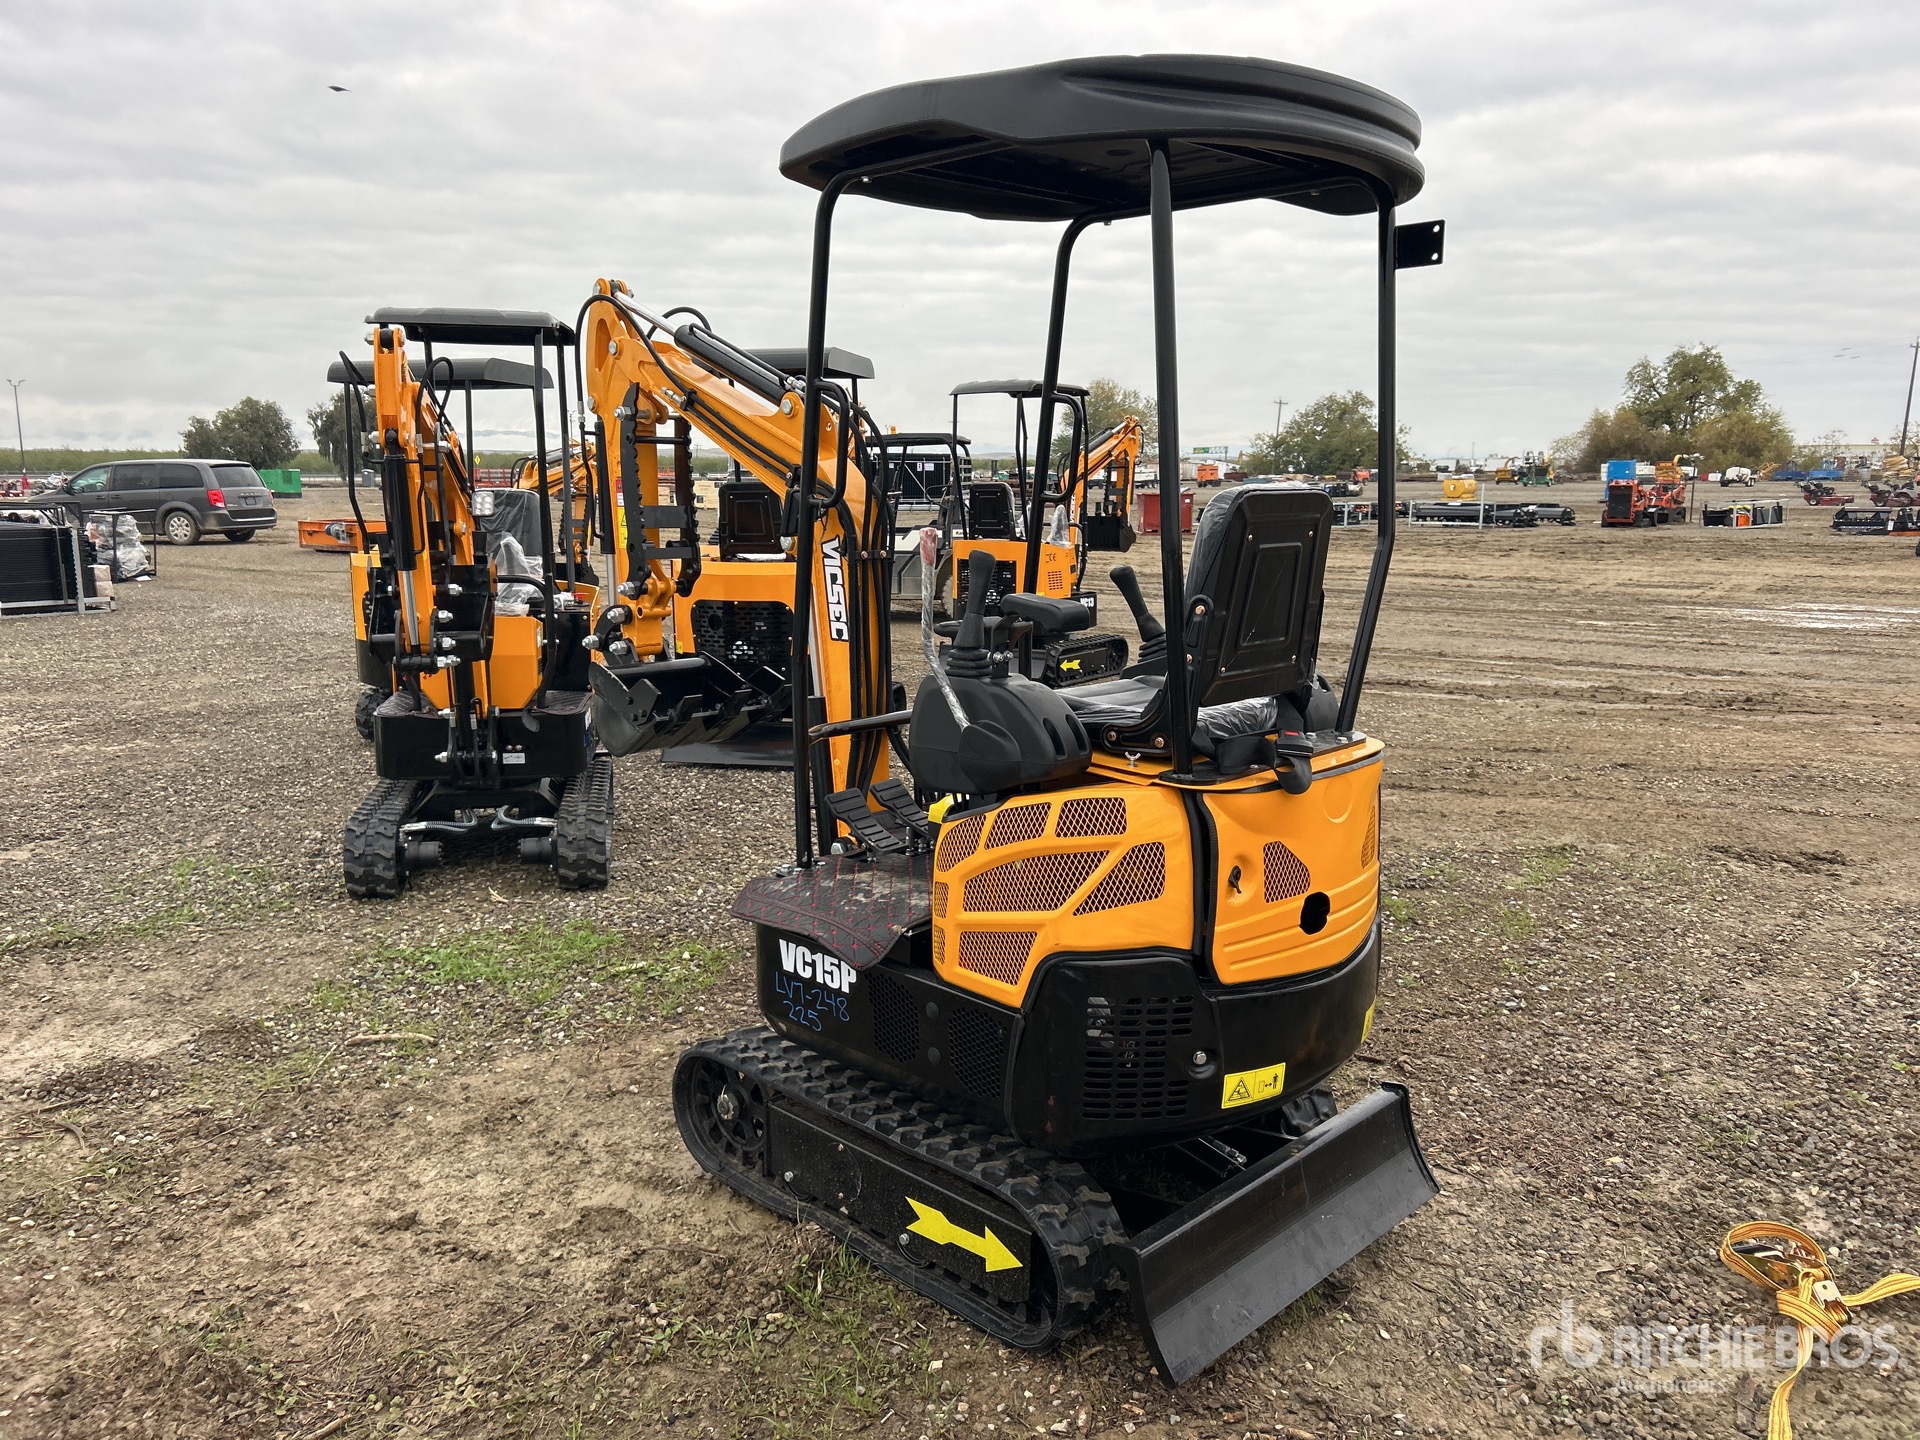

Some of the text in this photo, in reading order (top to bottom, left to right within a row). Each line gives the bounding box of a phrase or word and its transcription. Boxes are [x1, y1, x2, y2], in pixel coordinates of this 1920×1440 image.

[822, 536, 849, 641] VICSEC
[779, 940, 857, 993] VC15P
[784, 1001, 822, 1031] 225
